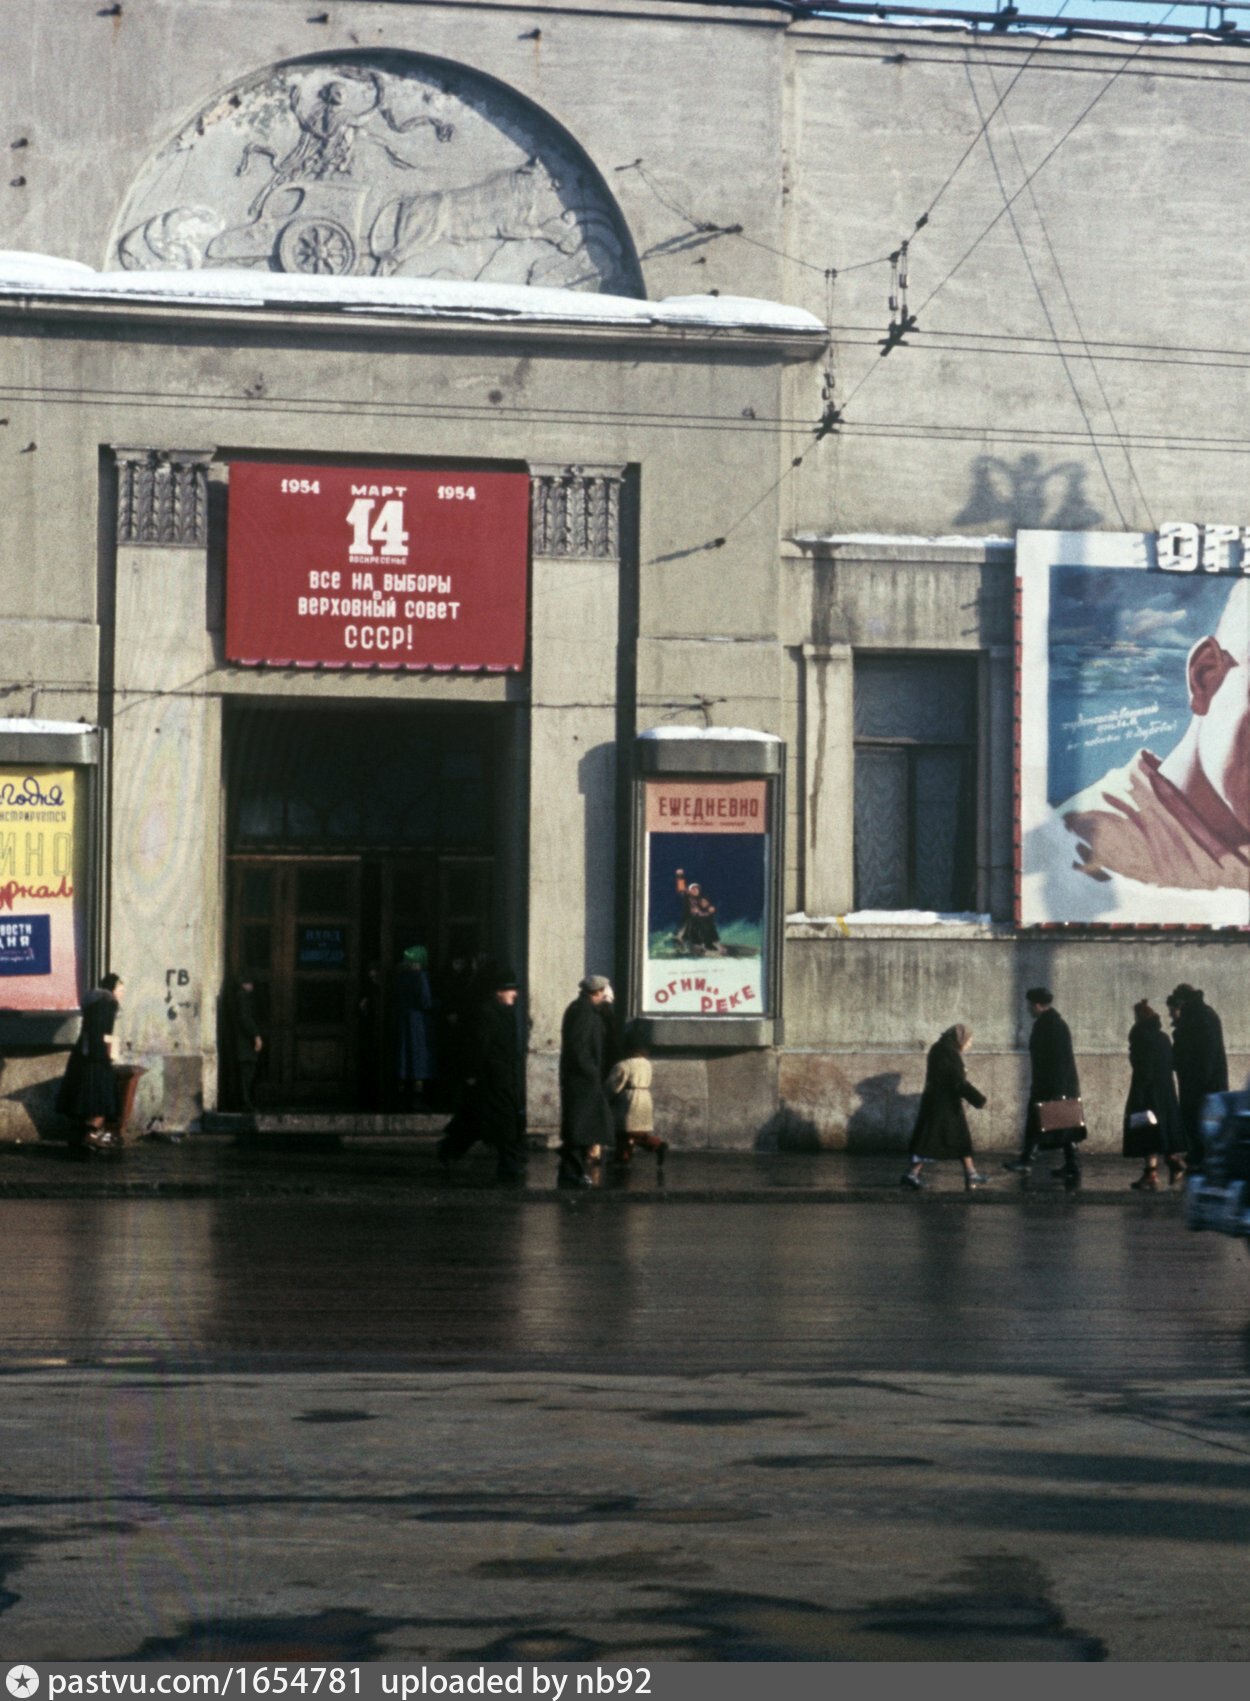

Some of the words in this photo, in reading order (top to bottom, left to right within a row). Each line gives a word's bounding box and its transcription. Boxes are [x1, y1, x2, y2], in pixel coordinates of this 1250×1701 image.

[281, 479, 320, 494] 1954
[351, 485, 407, 497] МАРТ
[437, 486, 476, 500] 1954
[346, 498, 409, 556] 14
[352, 573, 373, 590] НА
[384, 575, 451, 593] ВЫБОРЫ
[345, 624, 413, 650] СССР!
[0, 776, 65, 807] годня
[659, 797, 759, 819] ЕЖЕДНЕВНО
[166, 968, 190, 987] ГВ
[655, 978, 706, 1004] ОГНИ
[701, 985, 755, 1013] РЕКЕ
